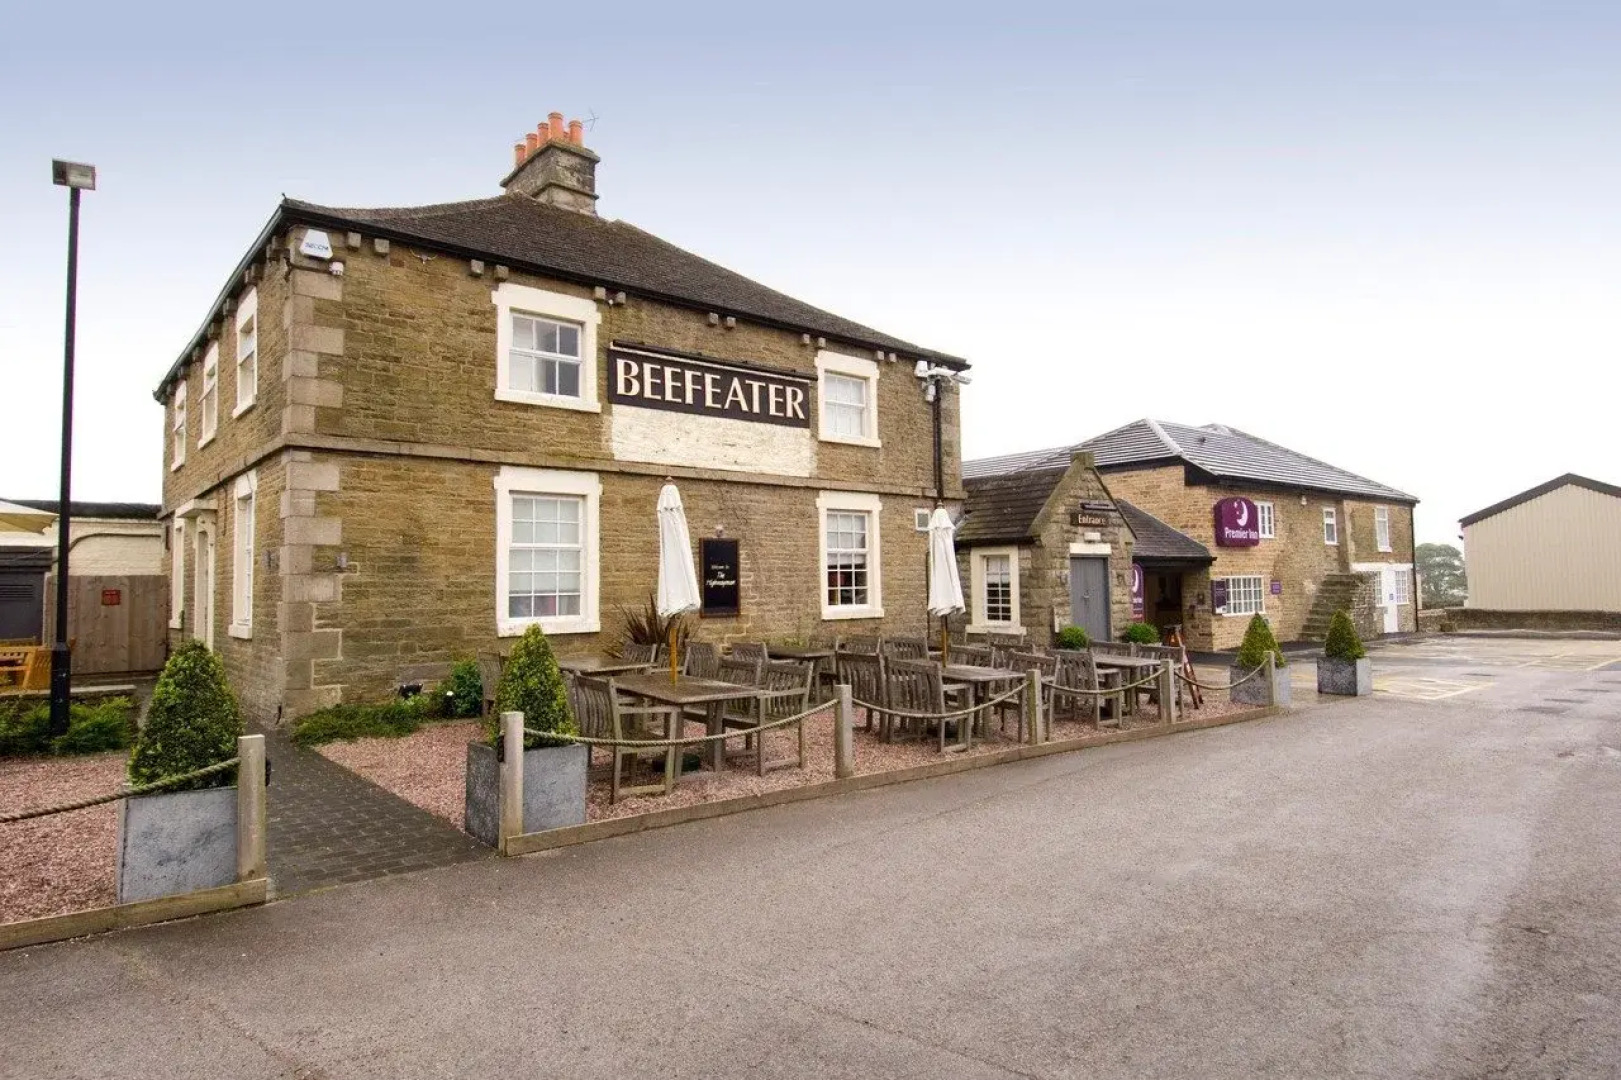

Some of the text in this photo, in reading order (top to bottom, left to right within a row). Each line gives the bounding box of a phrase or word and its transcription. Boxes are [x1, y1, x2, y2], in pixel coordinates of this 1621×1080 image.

[616, 358, 805, 419] BEEFEATER
[1078, 513, 1106, 525] Entrance
[1224, 527, 1258, 539] Premier Inn
